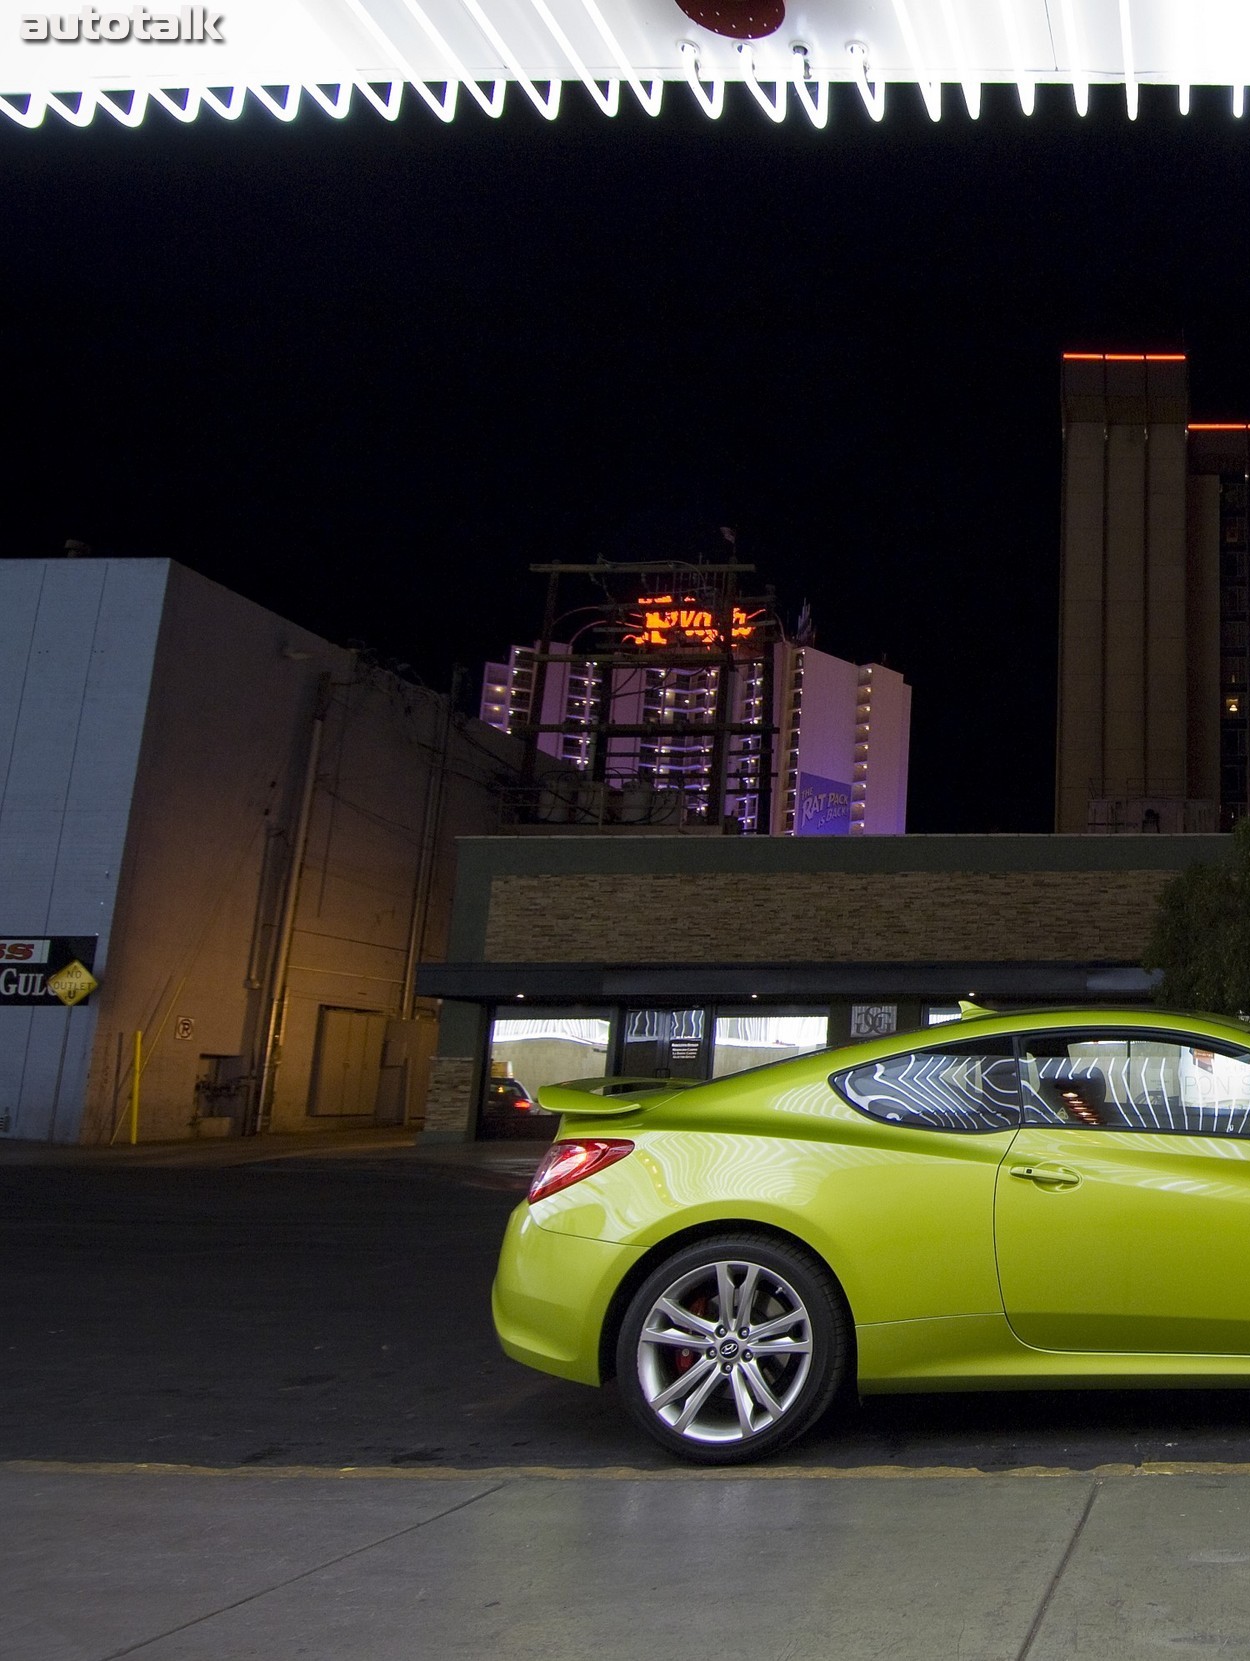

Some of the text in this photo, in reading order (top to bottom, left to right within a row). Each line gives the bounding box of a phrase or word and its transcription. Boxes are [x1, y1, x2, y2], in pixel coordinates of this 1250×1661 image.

[802, 793, 848, 828] RAT PACK
[67, 970, 82, 979] NO
[54, 982, 92, 991] OUTLET
